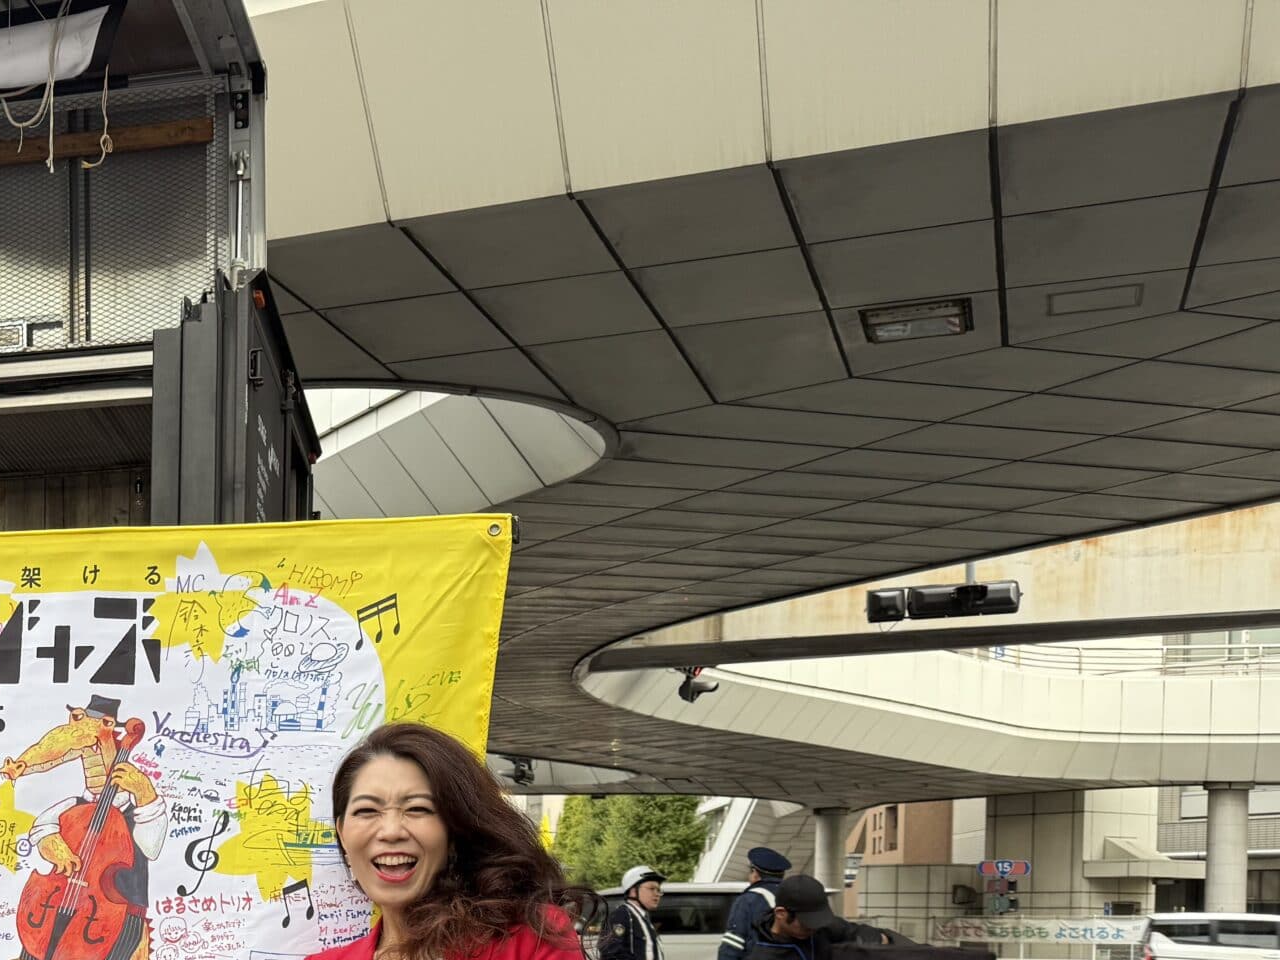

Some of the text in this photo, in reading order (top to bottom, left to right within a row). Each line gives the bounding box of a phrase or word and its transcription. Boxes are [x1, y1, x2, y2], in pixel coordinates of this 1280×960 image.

[176, 574, 205, 595] MC
[997, 862, 1011, 872] 15
[156, 891, 253, 915] はるさめトリオ
